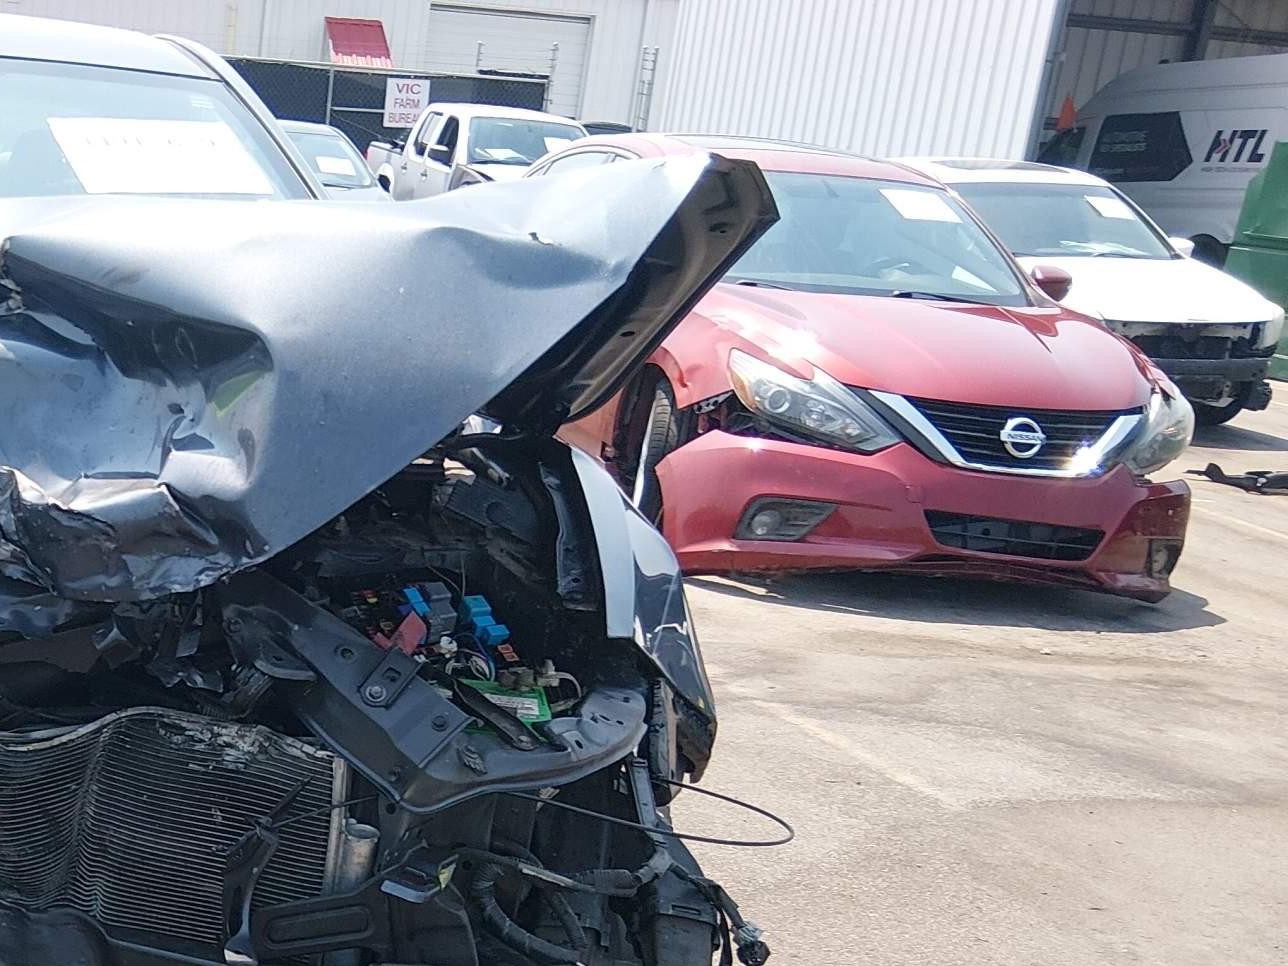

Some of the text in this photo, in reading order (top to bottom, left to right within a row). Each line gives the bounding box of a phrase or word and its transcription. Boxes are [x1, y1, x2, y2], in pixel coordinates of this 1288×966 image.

[396, 83, 422, 95] VIC
[394, 97, 420, 109] FARM
[388, 112, 421, 124] BUREA
[1203, 129, 1268, 163] HTL
